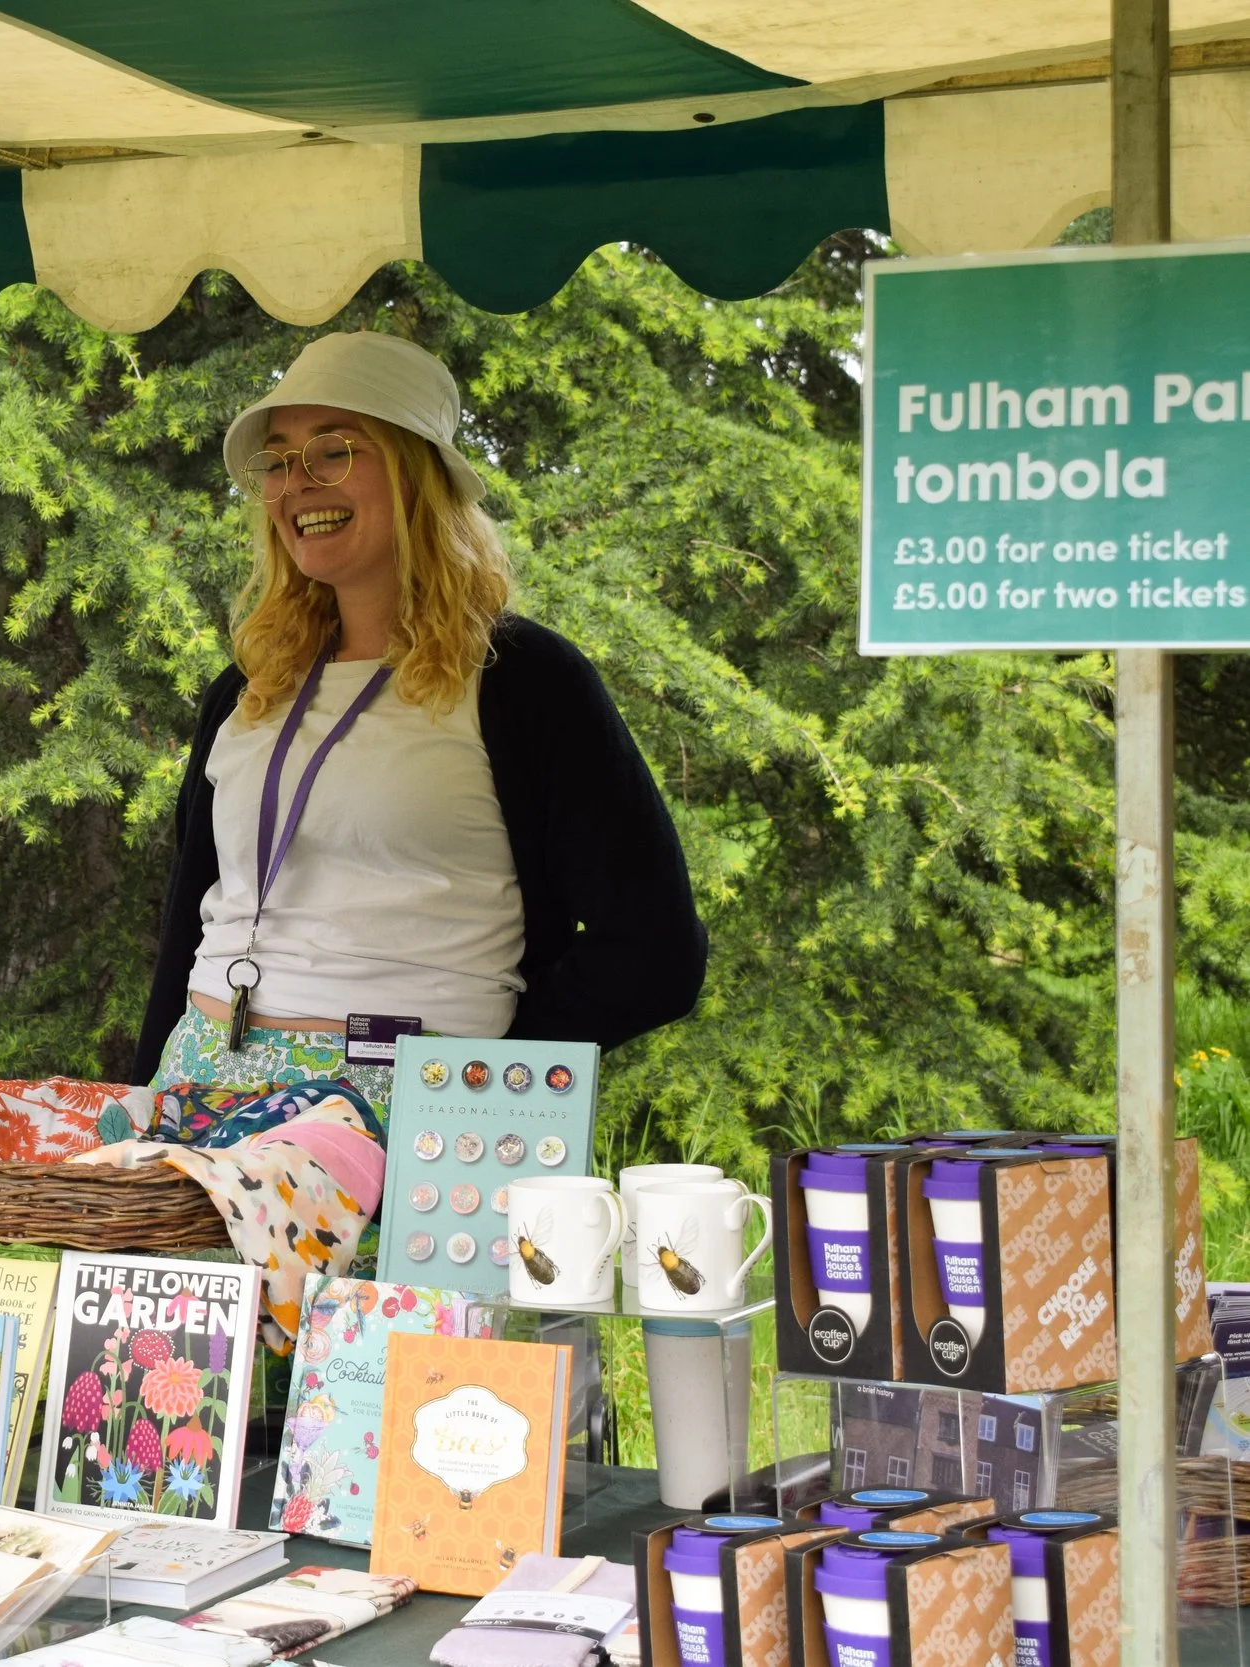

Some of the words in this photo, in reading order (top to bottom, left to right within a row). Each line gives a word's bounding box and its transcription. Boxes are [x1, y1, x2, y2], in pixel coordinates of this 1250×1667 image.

[898, 382, 1129, 433] Fulham
[894, 449, 1166, 504] tombola
[894, 537, 986, 565] £3.00
[996, 534, 1045, 563] for
[1053, 539, 1118, 562] one
[1128, 531, 1228, 561] ticket
[893, 583, 987, 610] £5.00
[997, 579, 1045, 609] for
[1054, 582, 1117, 609] two
[1128, 578, 1248, 609] tickets
[419, 1104, 498, 1116] SEASONAL
[509, 1109, 568, 1119] SALADS
[1001, 1197, 1062, 1264] CHOOSE
[824, 1243, 861, 1254] Fulham
[1031, 1233, 1051, 1259] TO
[825, 1252, 859, 1263] Palace
[944, 1255, 978, 1266] Fulham
[1022, 1231, 1074, 1289] RE-USE
[826, 1261, 854, 1271] House
[946, 1264, 976, 1275] Palace
[827, 1270, 862, 1280] Garden
[948, 1274, 972, 1284] House
[3, 1274, 38, 1293] RHS
[79, 1265, 129, 1290] THE
[132, 1270, 240, 1300] FLOWER
[949, 1282, 981, 1293] Garden
[1038, 1256, 1098, 1326] CHOOSE
[0, 1299, 23, 1309] BOOK
[1064, 1293, 1086, 1321] TO
[73, 1292, 239, 1337] GARDEN
[1058, 1291, 1108, 1350] RE-USE
[814, 1329, 848, 1340] ecoffee
[934, 1341, 965, 1353] ecoffee
[862, 1385, 876, 1395] brief
[876, 1387, 895, 1400] history
[351, 1400, 381, 1409] BOTANICAL
[446, 1410, 469, 1419] LITTLE
[472, 1411, 488, 1420] BOOK
[490, 1416, 498, 1424] OF
[83, 1510, 111, 1519] GROWING
[677, 1621, 706, 1634] Fulham
[679, 1632, 705, 1644] Palace
[682, 1650, 710, 1664] Garden
[837, 1644, 876, 1660] Fulham
